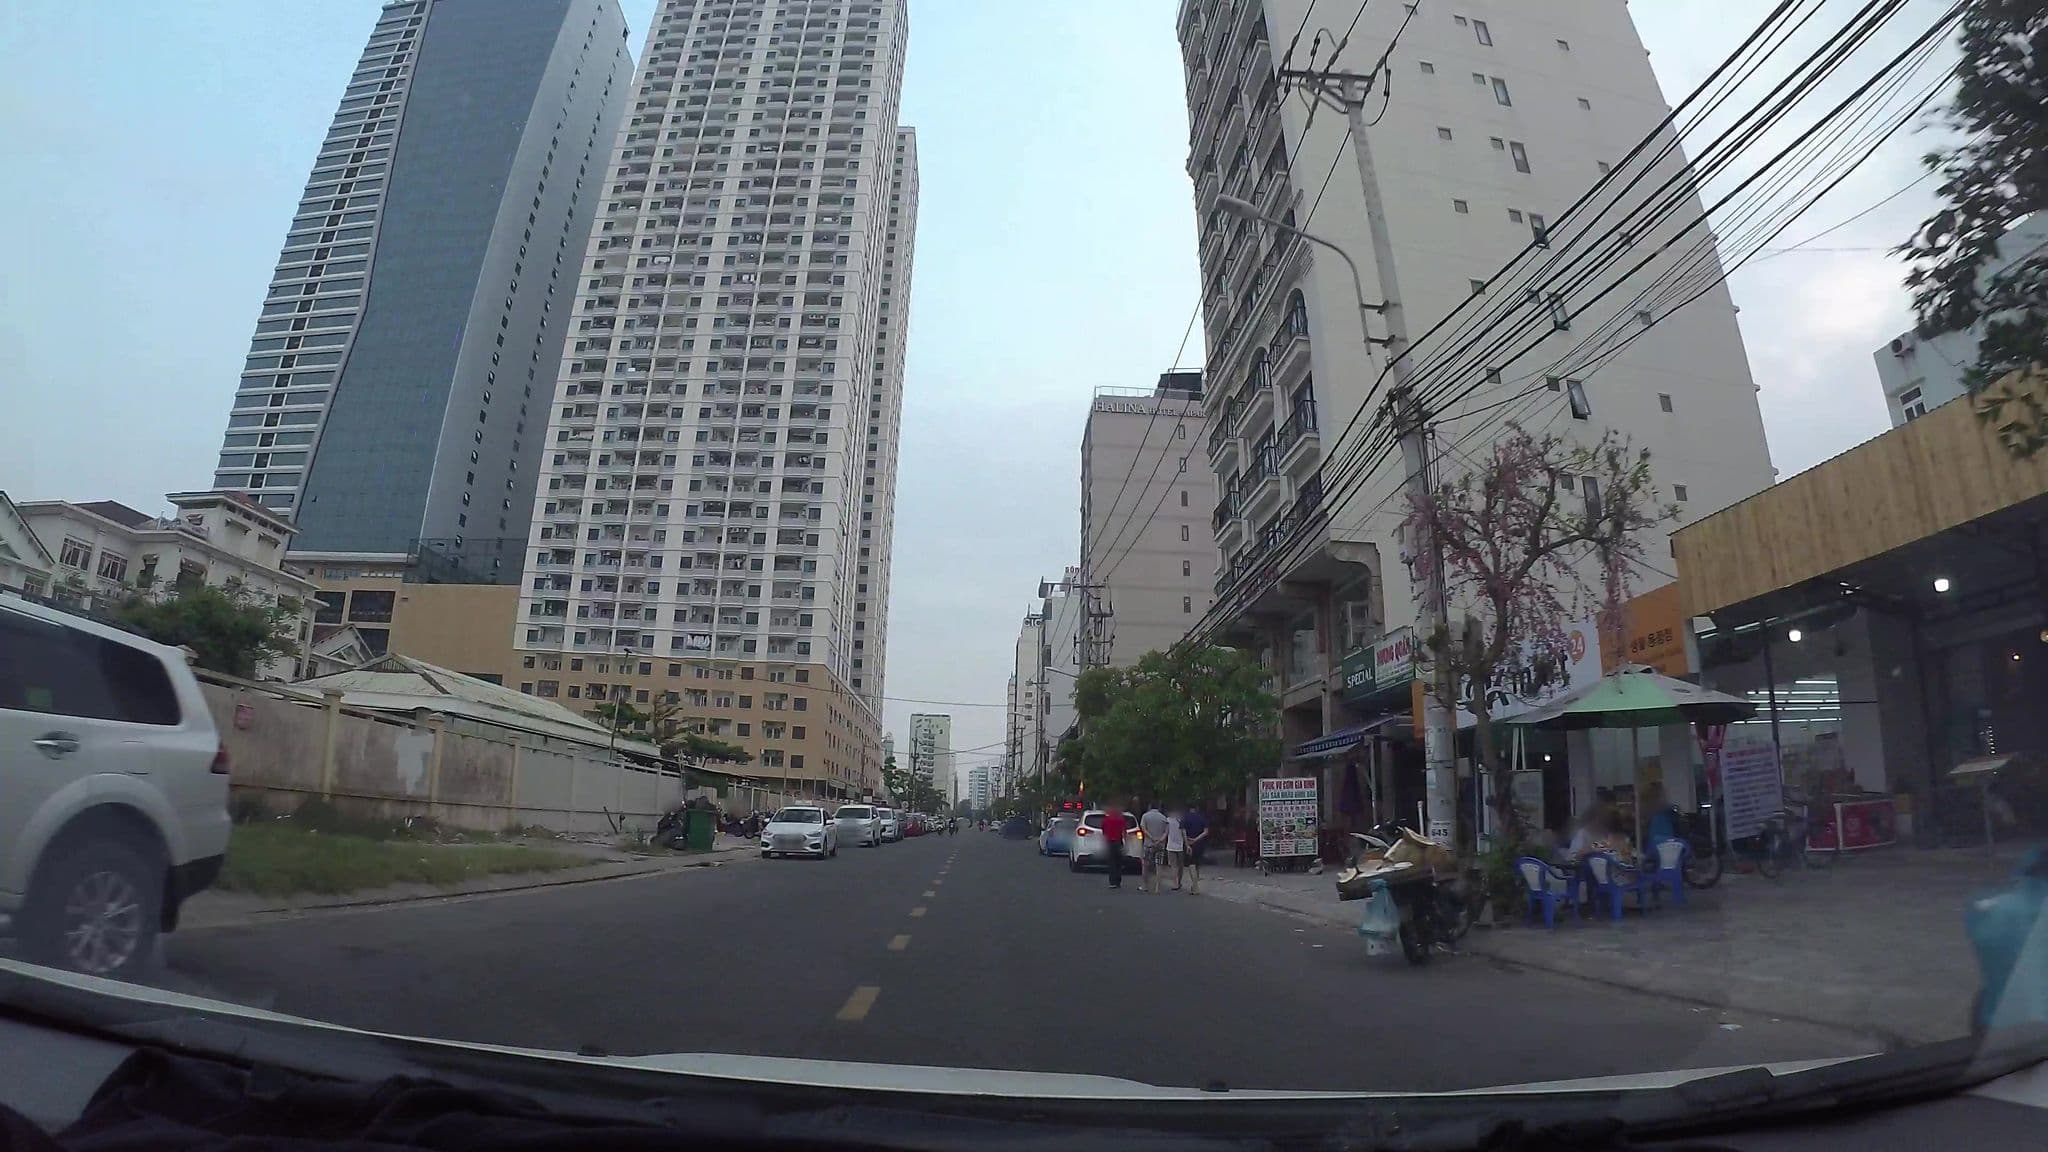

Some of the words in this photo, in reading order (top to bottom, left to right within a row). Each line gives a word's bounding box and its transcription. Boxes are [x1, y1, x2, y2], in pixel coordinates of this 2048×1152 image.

[1095, 401, 1146, 415] HALINA
[1571, 636, 1584, 655] 24
[1347, 667, 1374, 689] SPECIAL
